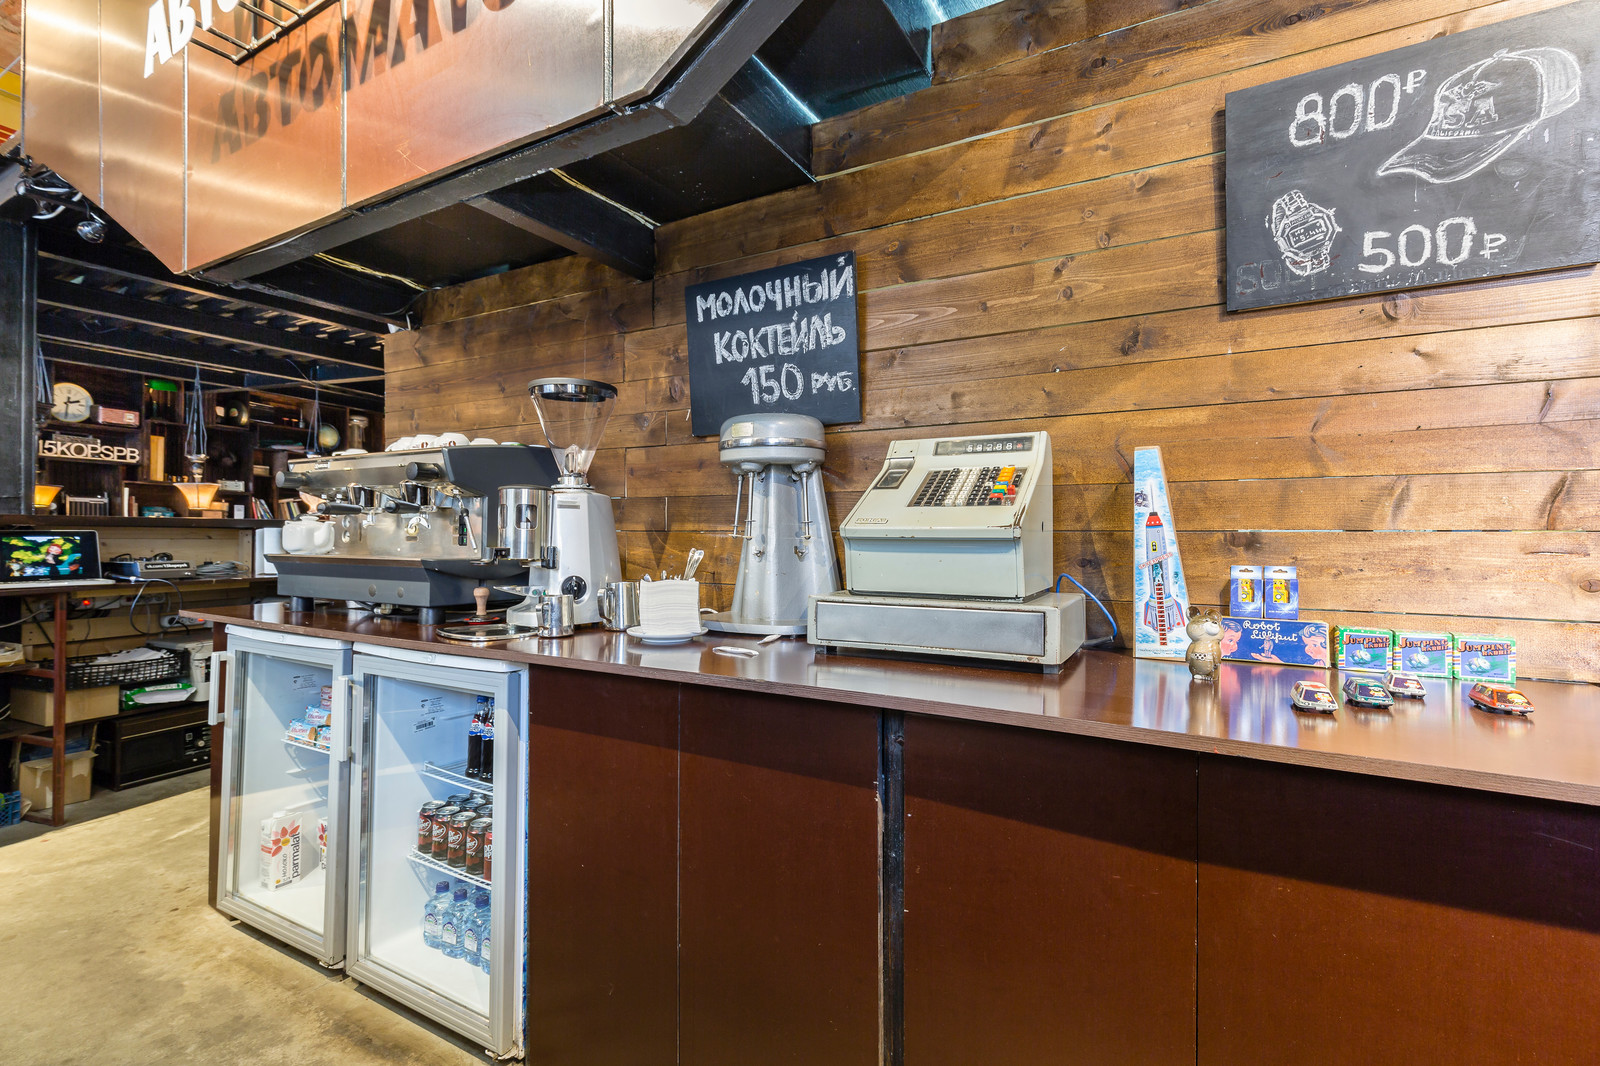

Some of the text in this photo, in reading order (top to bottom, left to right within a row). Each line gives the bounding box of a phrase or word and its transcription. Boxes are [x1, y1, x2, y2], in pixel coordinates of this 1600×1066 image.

[695, 253, 854, 323] МОЛОЧНЫЙ
[713, 310, 847, 365] КОКТЕЙЛЬ
[740, 362, 805, 405] 150
[38, 439, 140, 463] 15KOPSPB
[1242, 620, 1281, 631] Robot
[1250, 629, 1299, 643] Lilliput
[290, 832, 301, 879] parmalat
